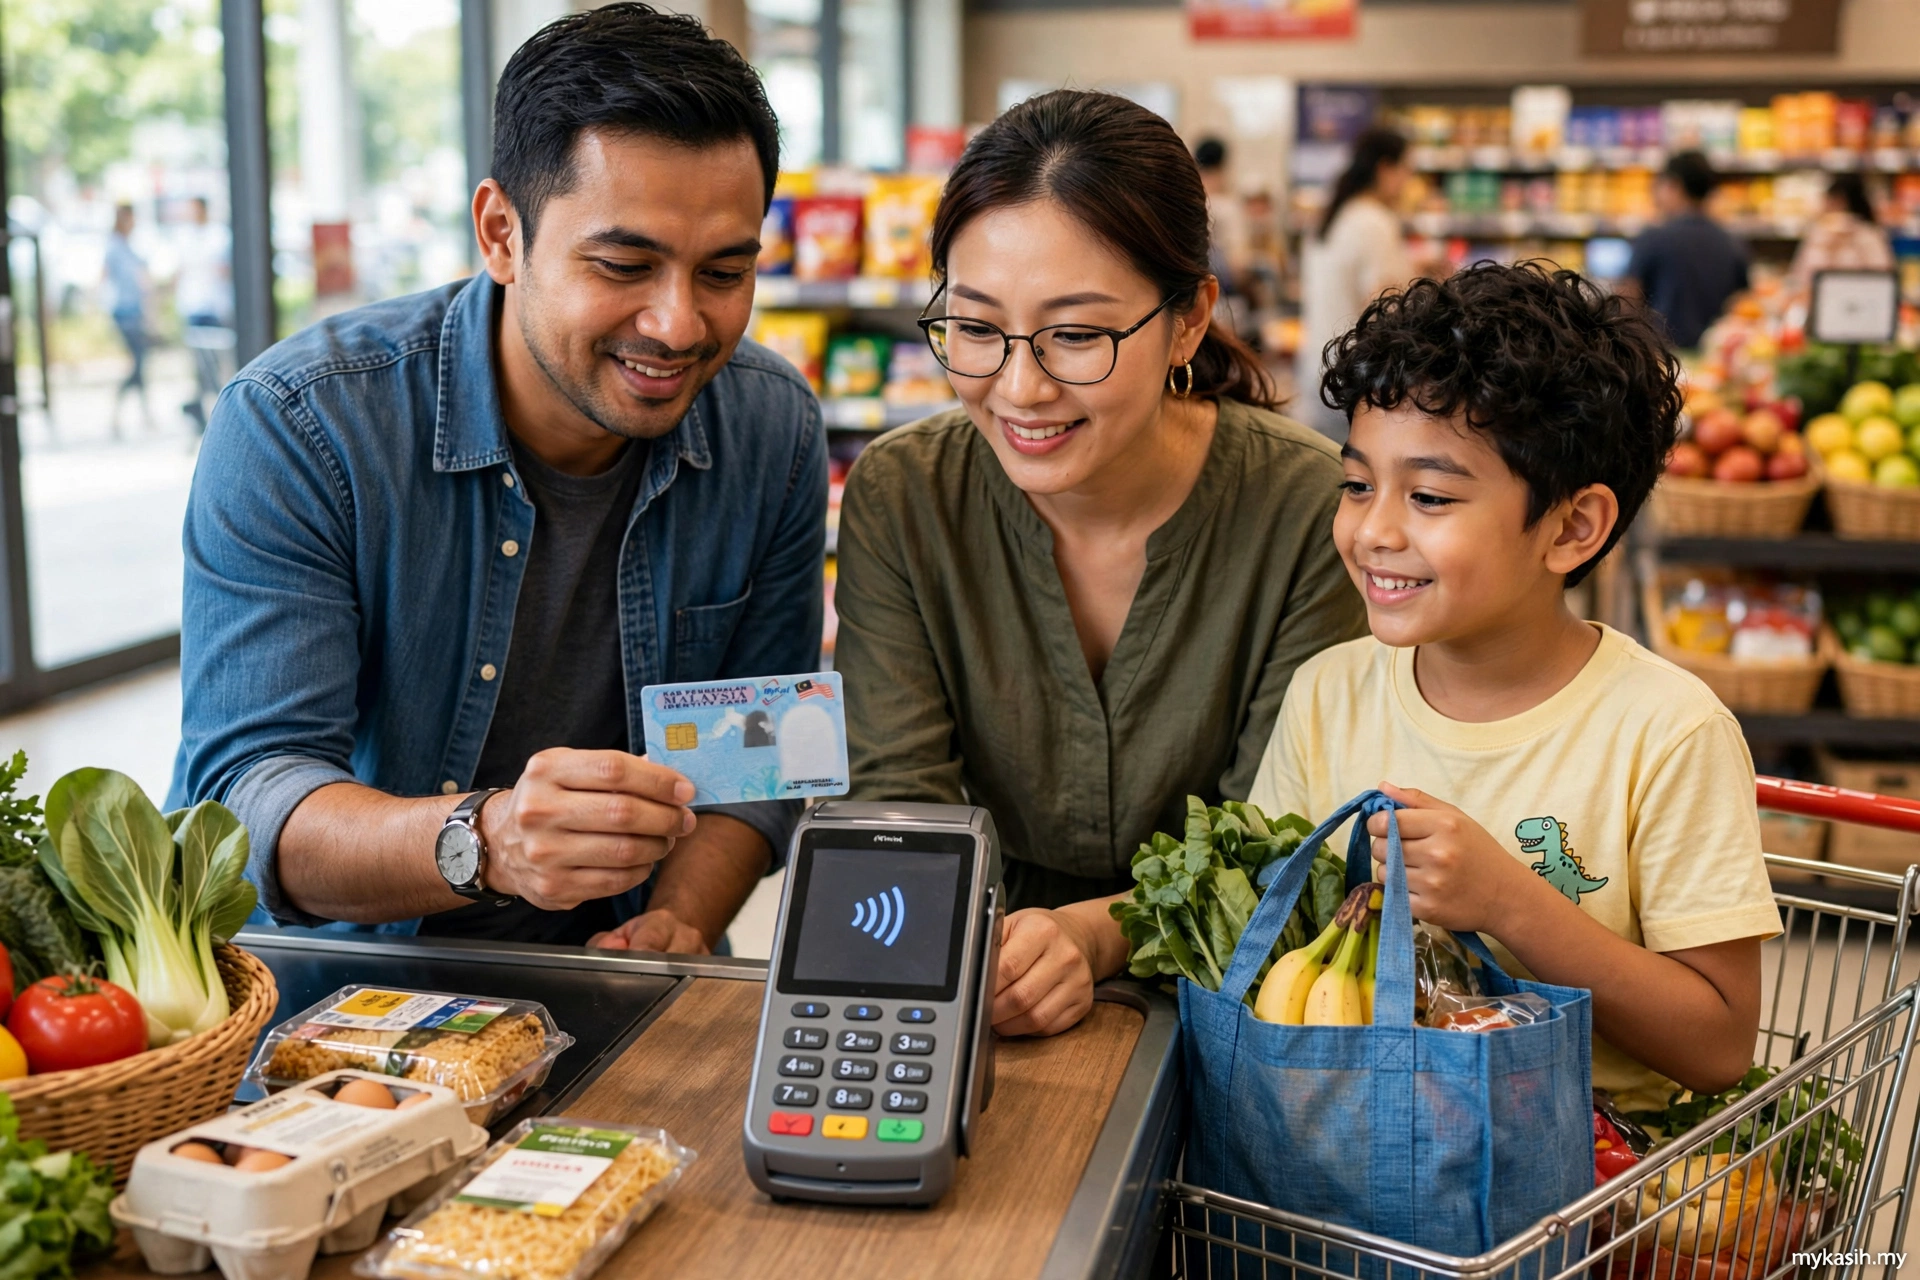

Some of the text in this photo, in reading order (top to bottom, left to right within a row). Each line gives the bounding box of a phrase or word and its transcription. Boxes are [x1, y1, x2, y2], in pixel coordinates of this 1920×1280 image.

[664, 692, 747, 704] MALAYSIA
[794, 1029, 802, 1044] 1
[844, 1032, 857, 1047] 2
[898, 1035, 910, 1050] 3
[785, 1057, 798, 1072] 4
[840, 1060, 853, 1075] 5
[893, 1063, 906, 1079] 6
[782, 1085, 795, 1101] 7
[835, 1089, 848, 1104] 8
[889, 1092, 902, 1107] 9
